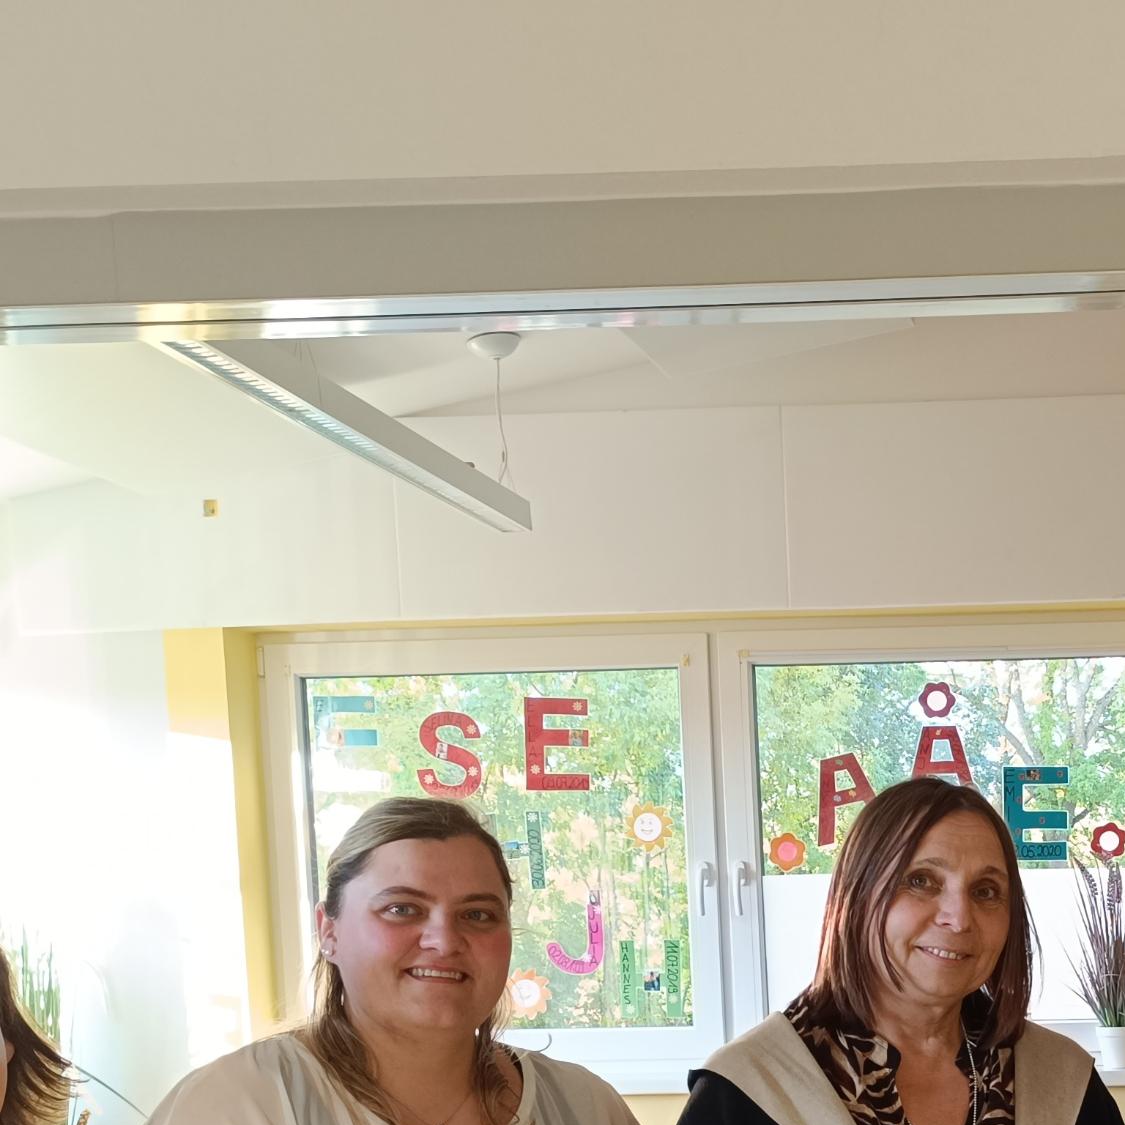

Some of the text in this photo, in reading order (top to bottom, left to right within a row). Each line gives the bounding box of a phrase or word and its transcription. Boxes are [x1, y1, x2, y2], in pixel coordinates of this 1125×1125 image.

[417, 711, 482, 799] S
[524, 697, 590, 790] E
[1004, 767, 1068, 860] E
[547, 890, 604, 974] J
[621, 942, 631, 1005] HANNES
